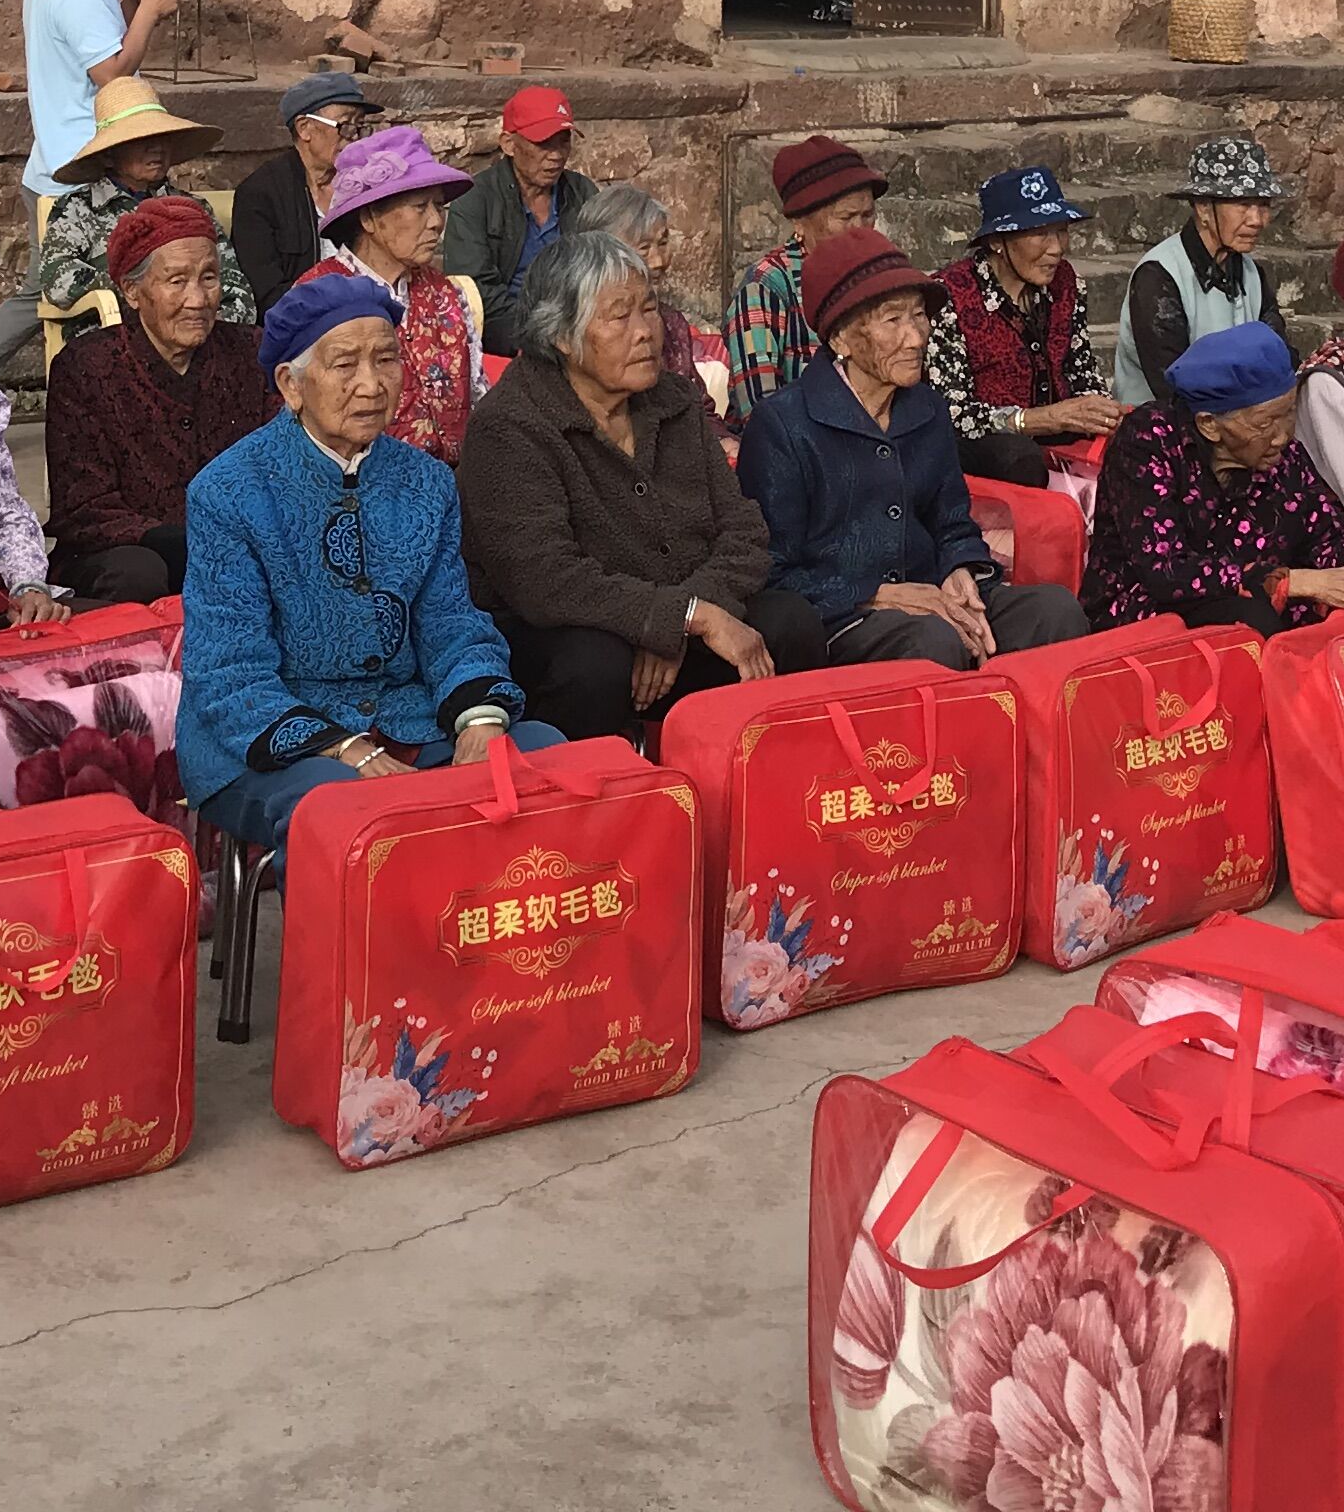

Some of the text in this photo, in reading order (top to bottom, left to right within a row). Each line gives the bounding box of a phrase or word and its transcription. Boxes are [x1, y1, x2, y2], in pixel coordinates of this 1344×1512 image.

[1125, 718, 1228, 773] 超柔软毛毯
[831, 857, 948, 897] Super soft blanket
[456, 879, 623, 949] 超柔软毛毯
[913, 937, 993, 961] GOOD HEALTH
[471, 974, 613, 1025] Super soft blanket
[22, 1053, 89, 1085] blanket
[573, 1057, 667, 1090] GOOD HEALTH
[40, 1135, 152, 1175] GOOD HEALTH
